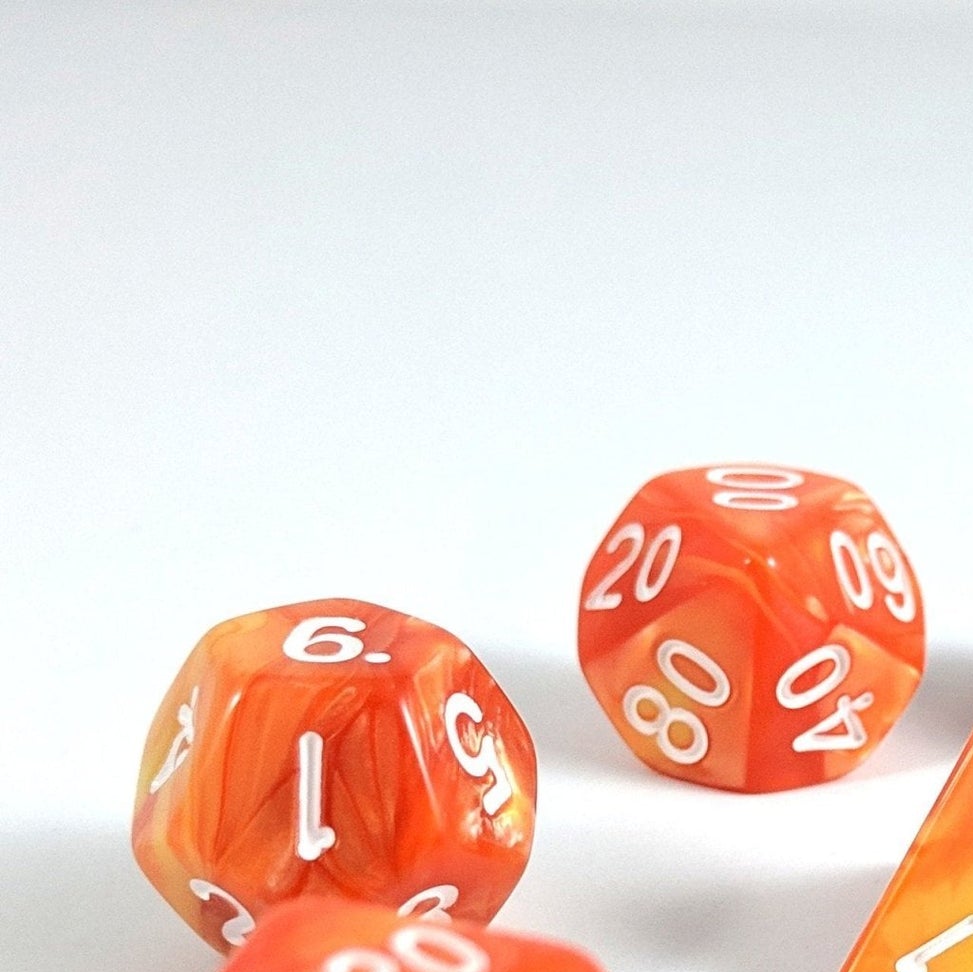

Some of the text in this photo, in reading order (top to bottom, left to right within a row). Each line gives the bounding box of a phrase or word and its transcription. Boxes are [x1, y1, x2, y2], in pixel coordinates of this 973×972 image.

[706, 466, 804, 511] 00
[584, 522, 681, 611] 20
[444, 692, 512, 816] 5
[623, 639, 730, 764] 80
[775, 644, 874, 753] 40
[298, 731, 335, 861] 1
